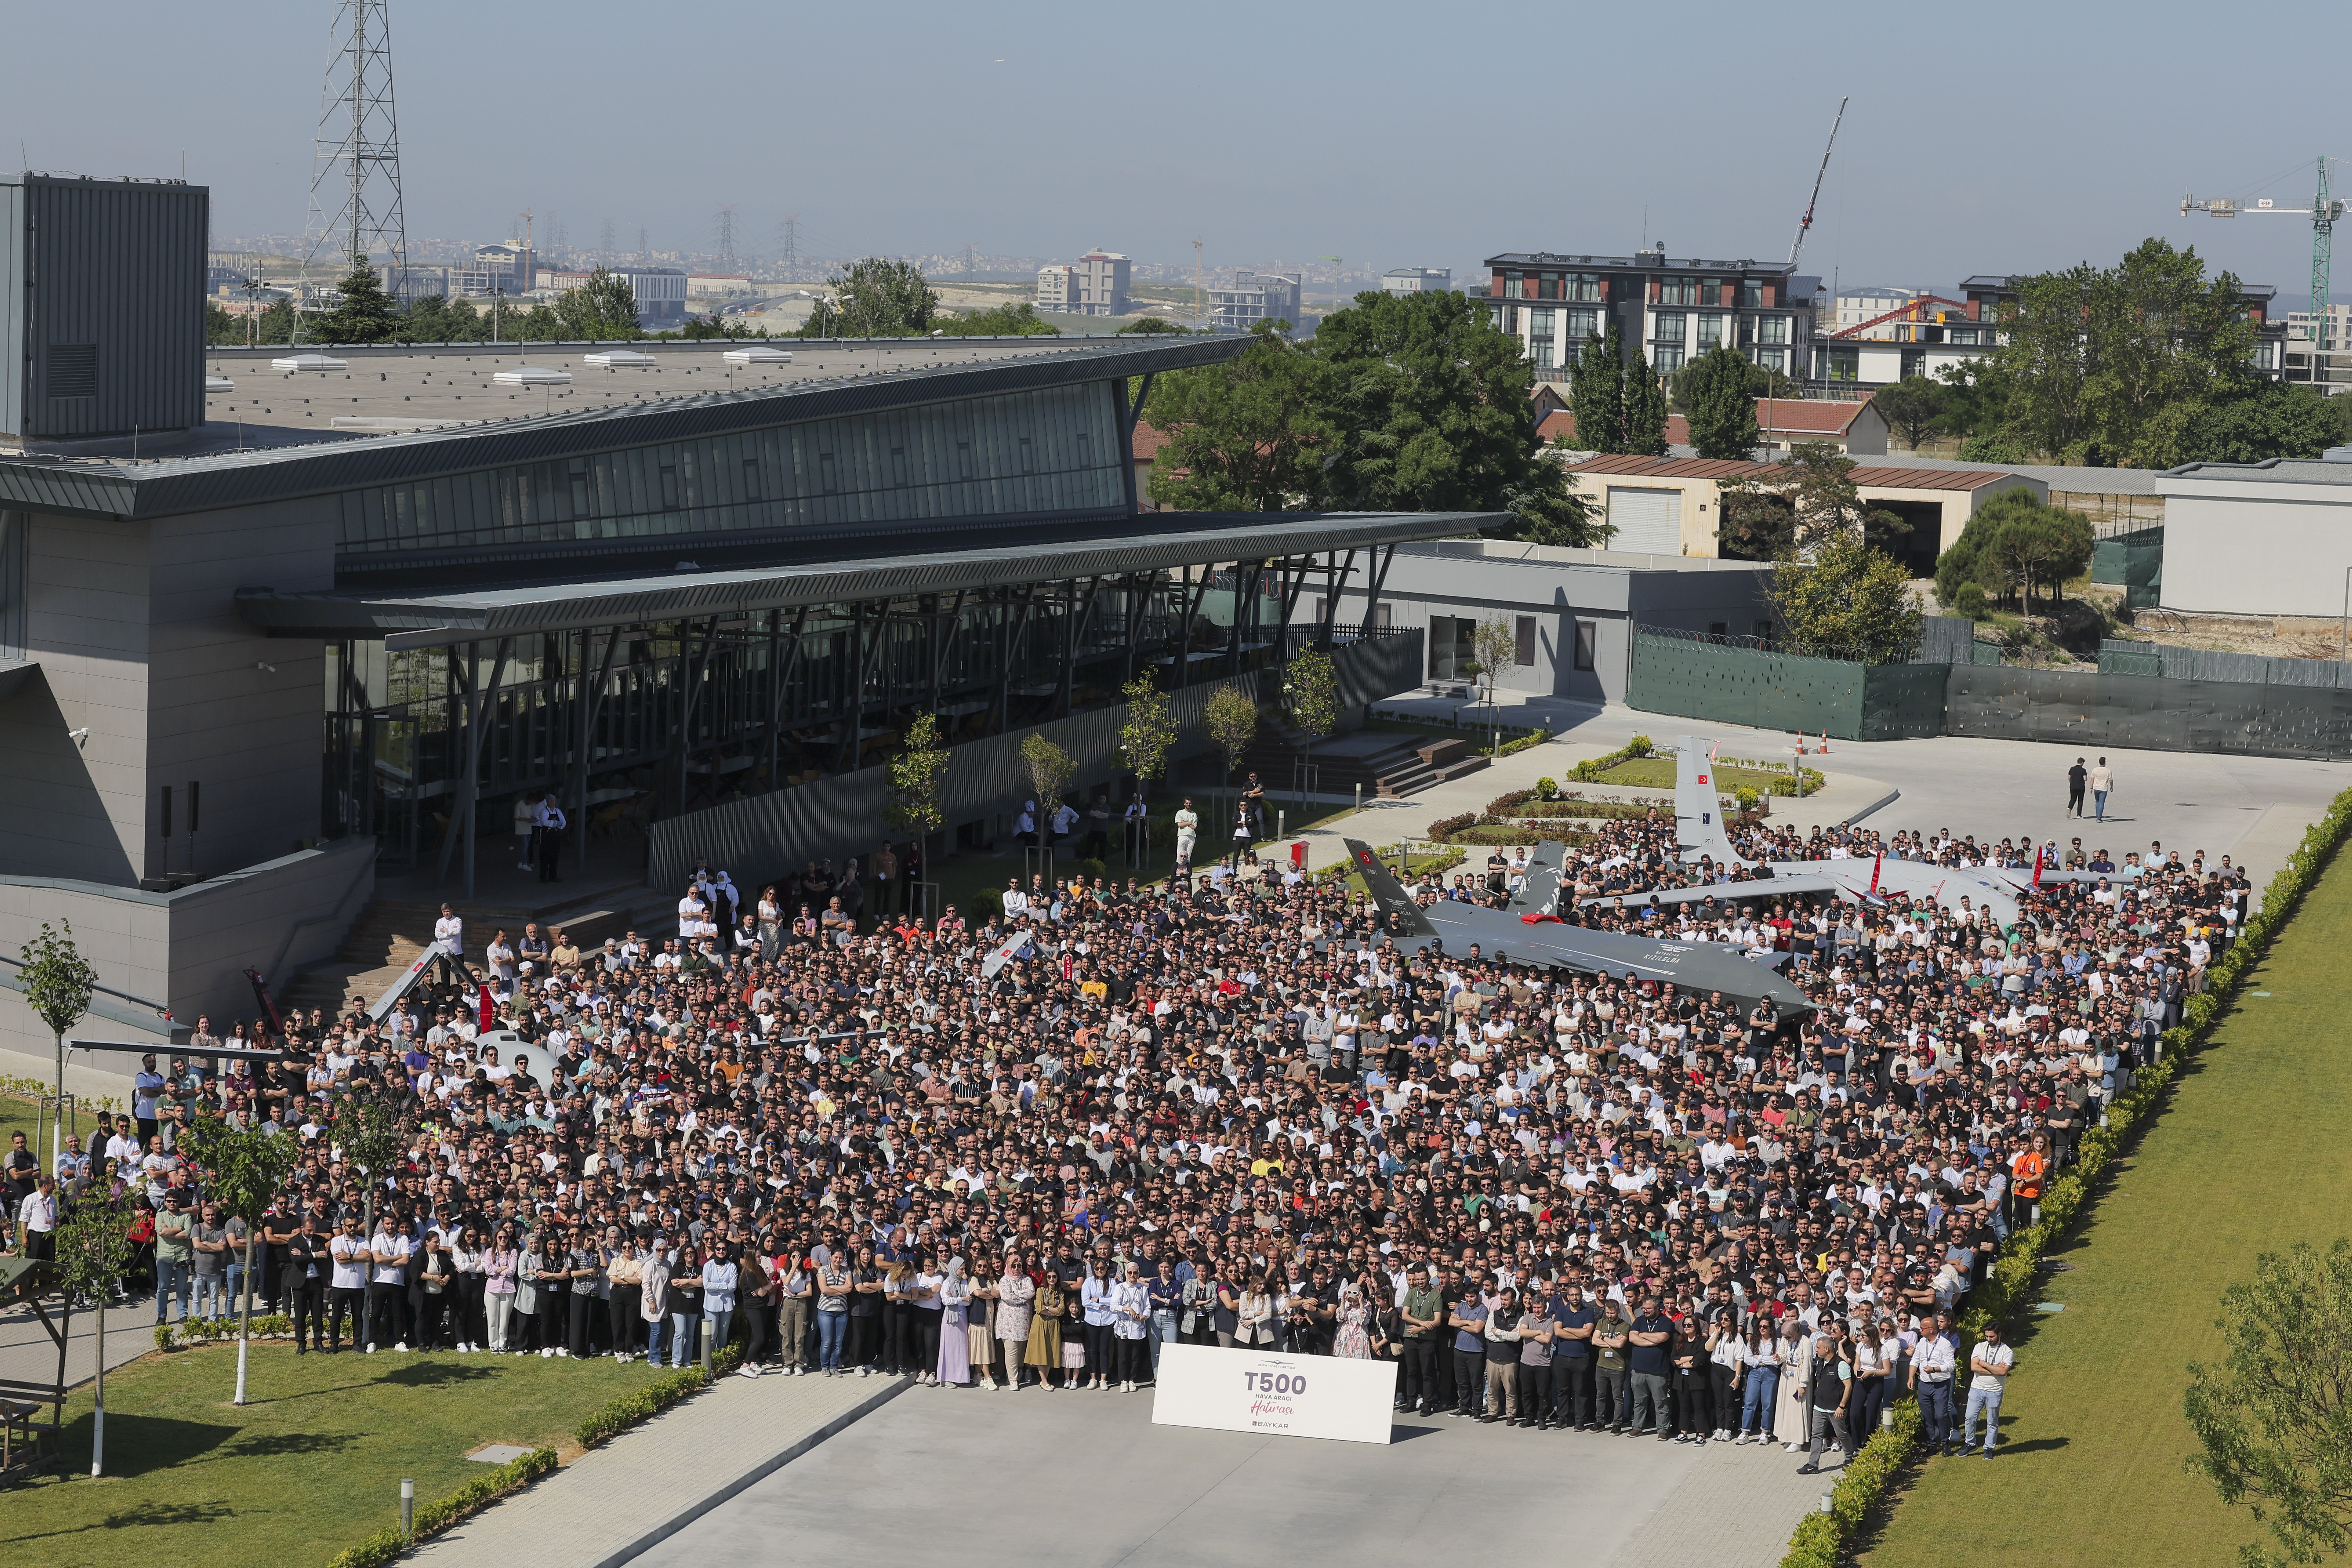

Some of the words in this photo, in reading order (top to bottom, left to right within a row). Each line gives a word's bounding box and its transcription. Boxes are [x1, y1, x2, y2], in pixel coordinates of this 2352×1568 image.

[1643, 954, 1680, 964] KIZILELMA
[1244, 1372, 1306, 1395] T500
[1250, 1399, 1294, 1416] Hatırası
